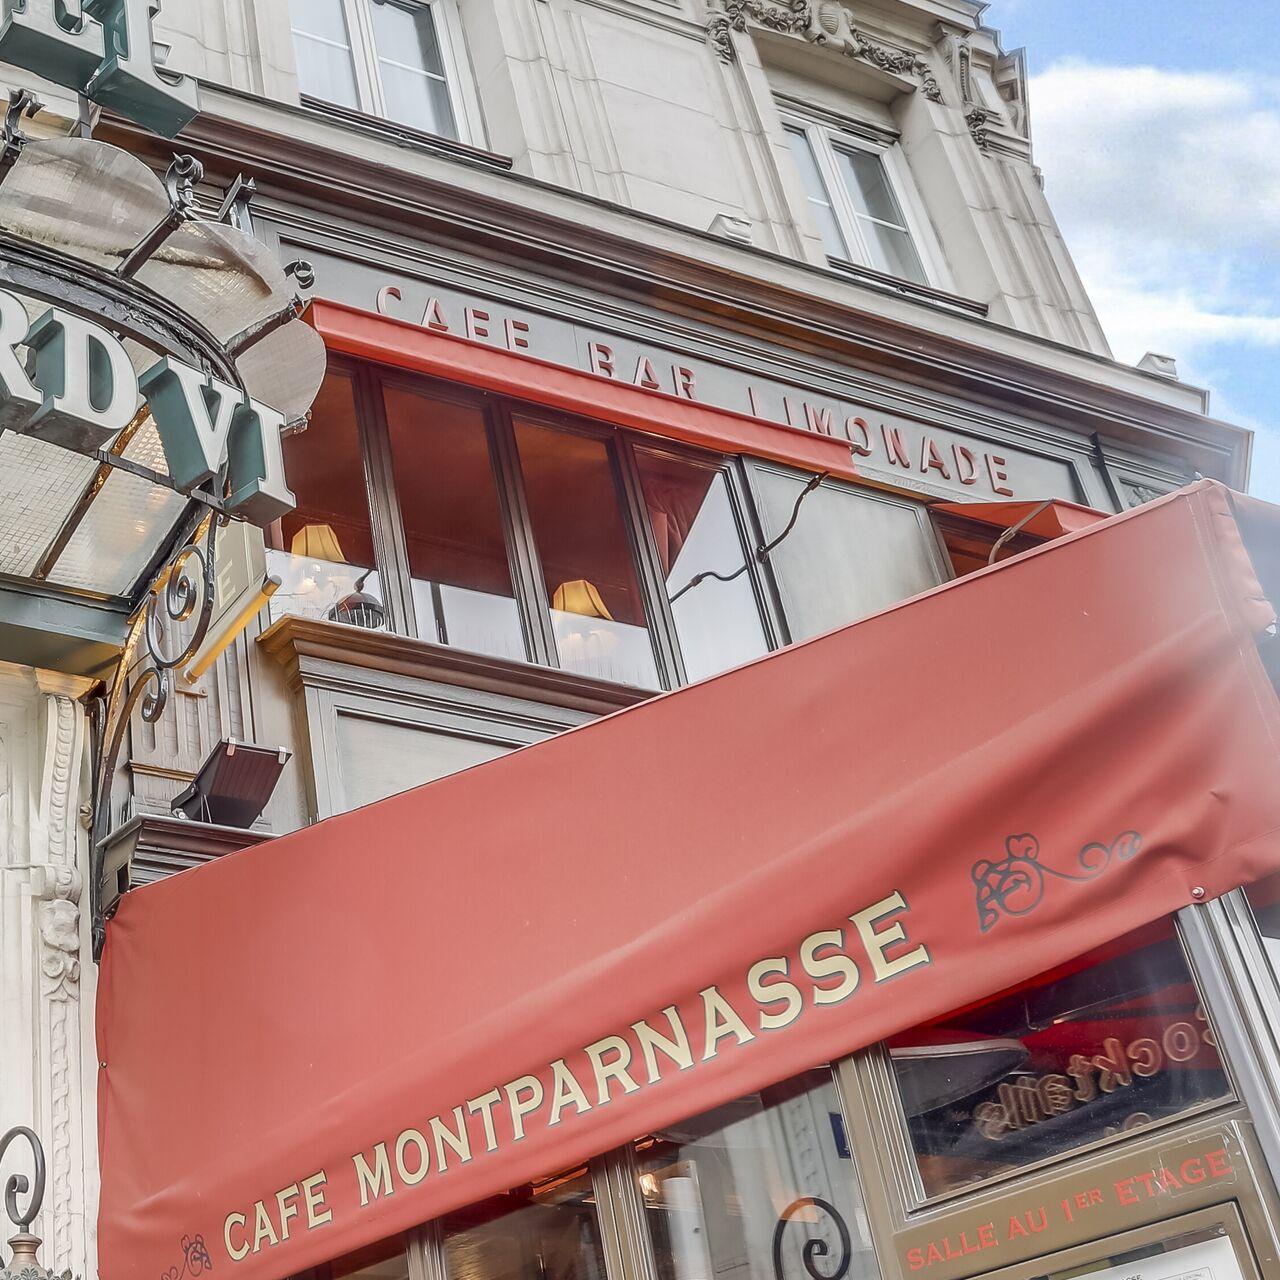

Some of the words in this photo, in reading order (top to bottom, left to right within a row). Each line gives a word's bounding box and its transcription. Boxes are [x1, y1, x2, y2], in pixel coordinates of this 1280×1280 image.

[376, 285, 530, 352] CAFE
[588, 340, 698, 400] BAR
[139, 355, 297, 525] VI
[223, 1168, 334, 1263] CAFE
[351, 889, 931, 1208] MONTPARNASSE
[907, 1222, 1000, 1272] SALLE
[1007, 1206, 1049, 1241] AU
[1114, 1148, 1233, 1207] ETAGE
